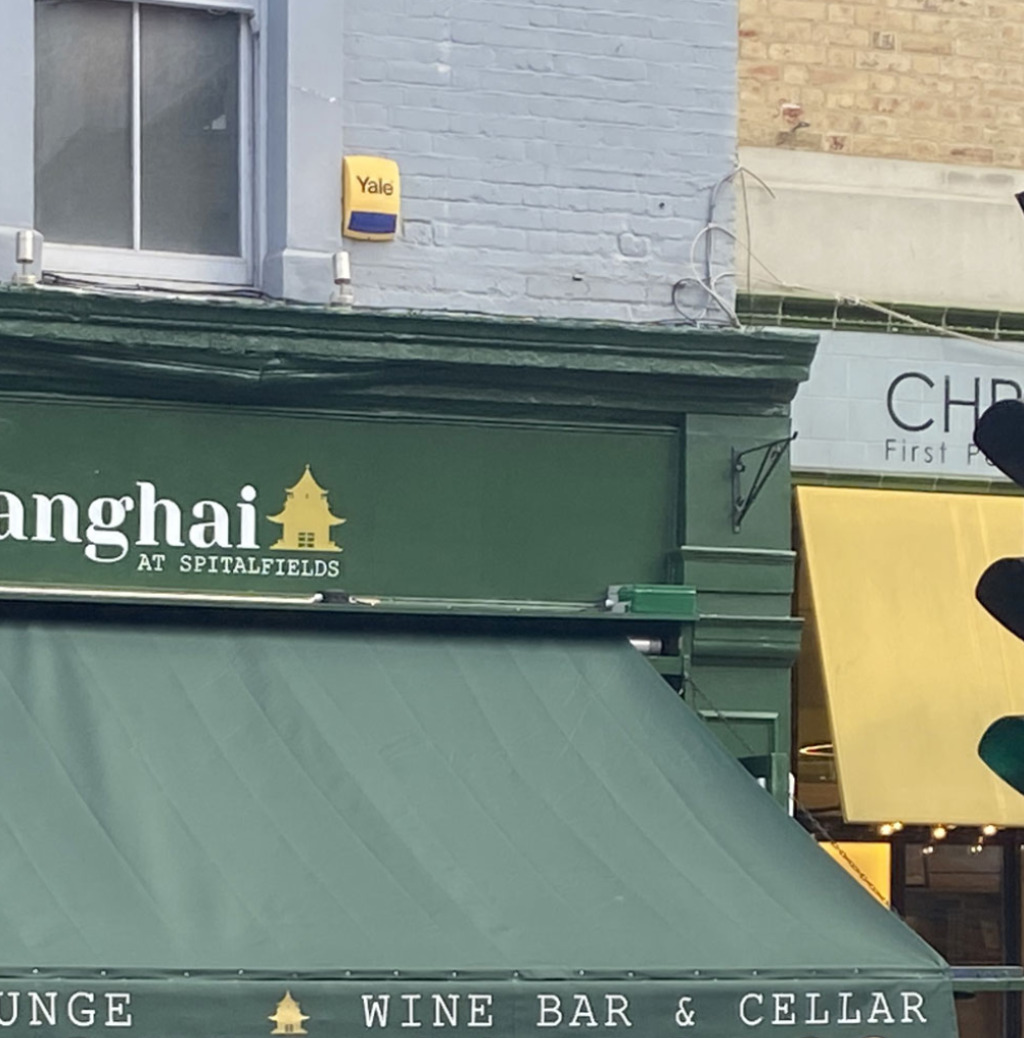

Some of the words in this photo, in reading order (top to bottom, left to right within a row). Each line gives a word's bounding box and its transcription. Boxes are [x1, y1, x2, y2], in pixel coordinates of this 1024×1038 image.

[356, 175, 394, 196] Yale
[884, 438, 947, 464] First
[137, 554, 166, 573] AT
[179, 555, 341, 578] SPITALFIELDS
[362, 993, 494, 1029] WINE
[536, 993, 633, 1029] BAR
[676, 995, 696, 1028] &
[739, 991, 928, 1028] CELLAR
